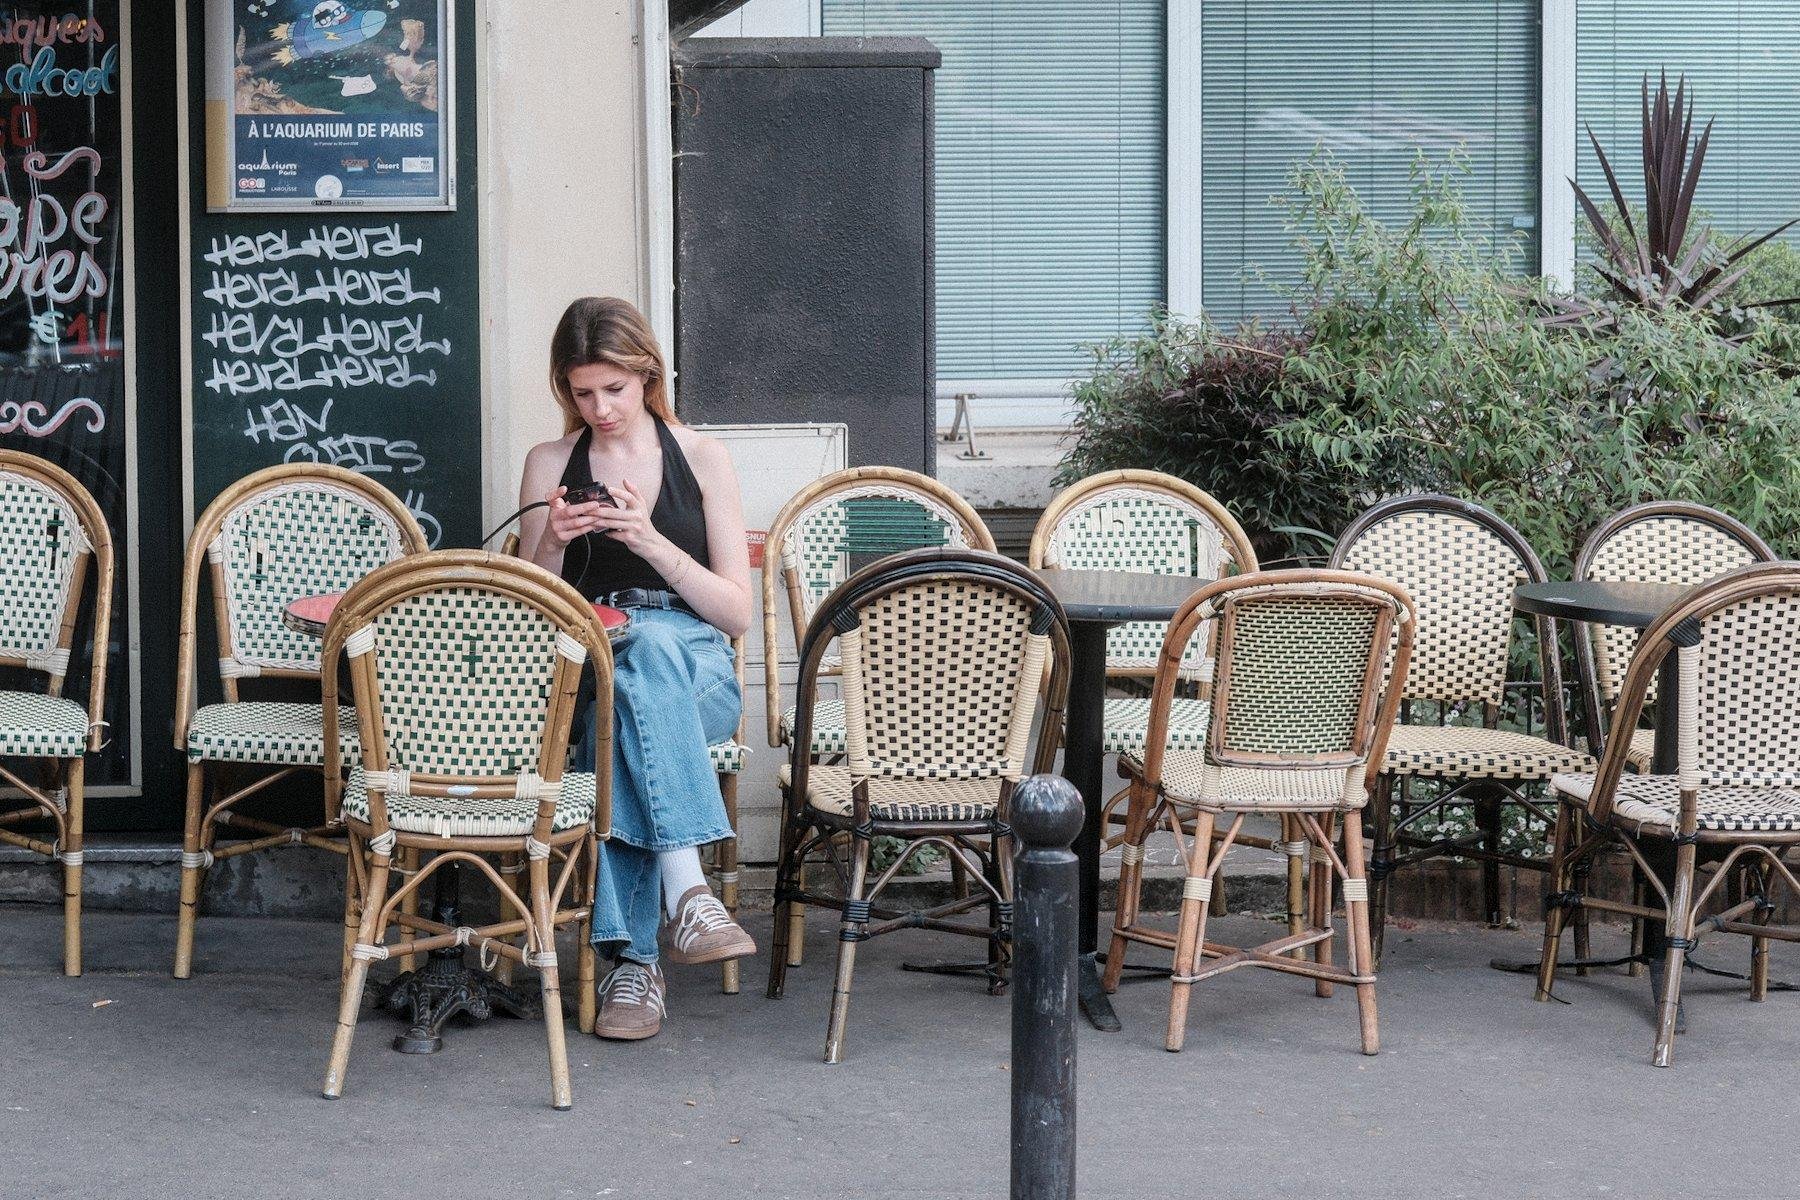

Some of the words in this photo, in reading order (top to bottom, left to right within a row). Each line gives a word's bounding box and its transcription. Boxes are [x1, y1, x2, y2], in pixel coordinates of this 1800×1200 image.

[5, 43, 118, 97] alcool
[248, 120, 260, 138] À
[263, 122, 353, 139] L'AQUARIUM
[357, 122, 377, 138] DE
[380, 122, 424, 138] PARIS
